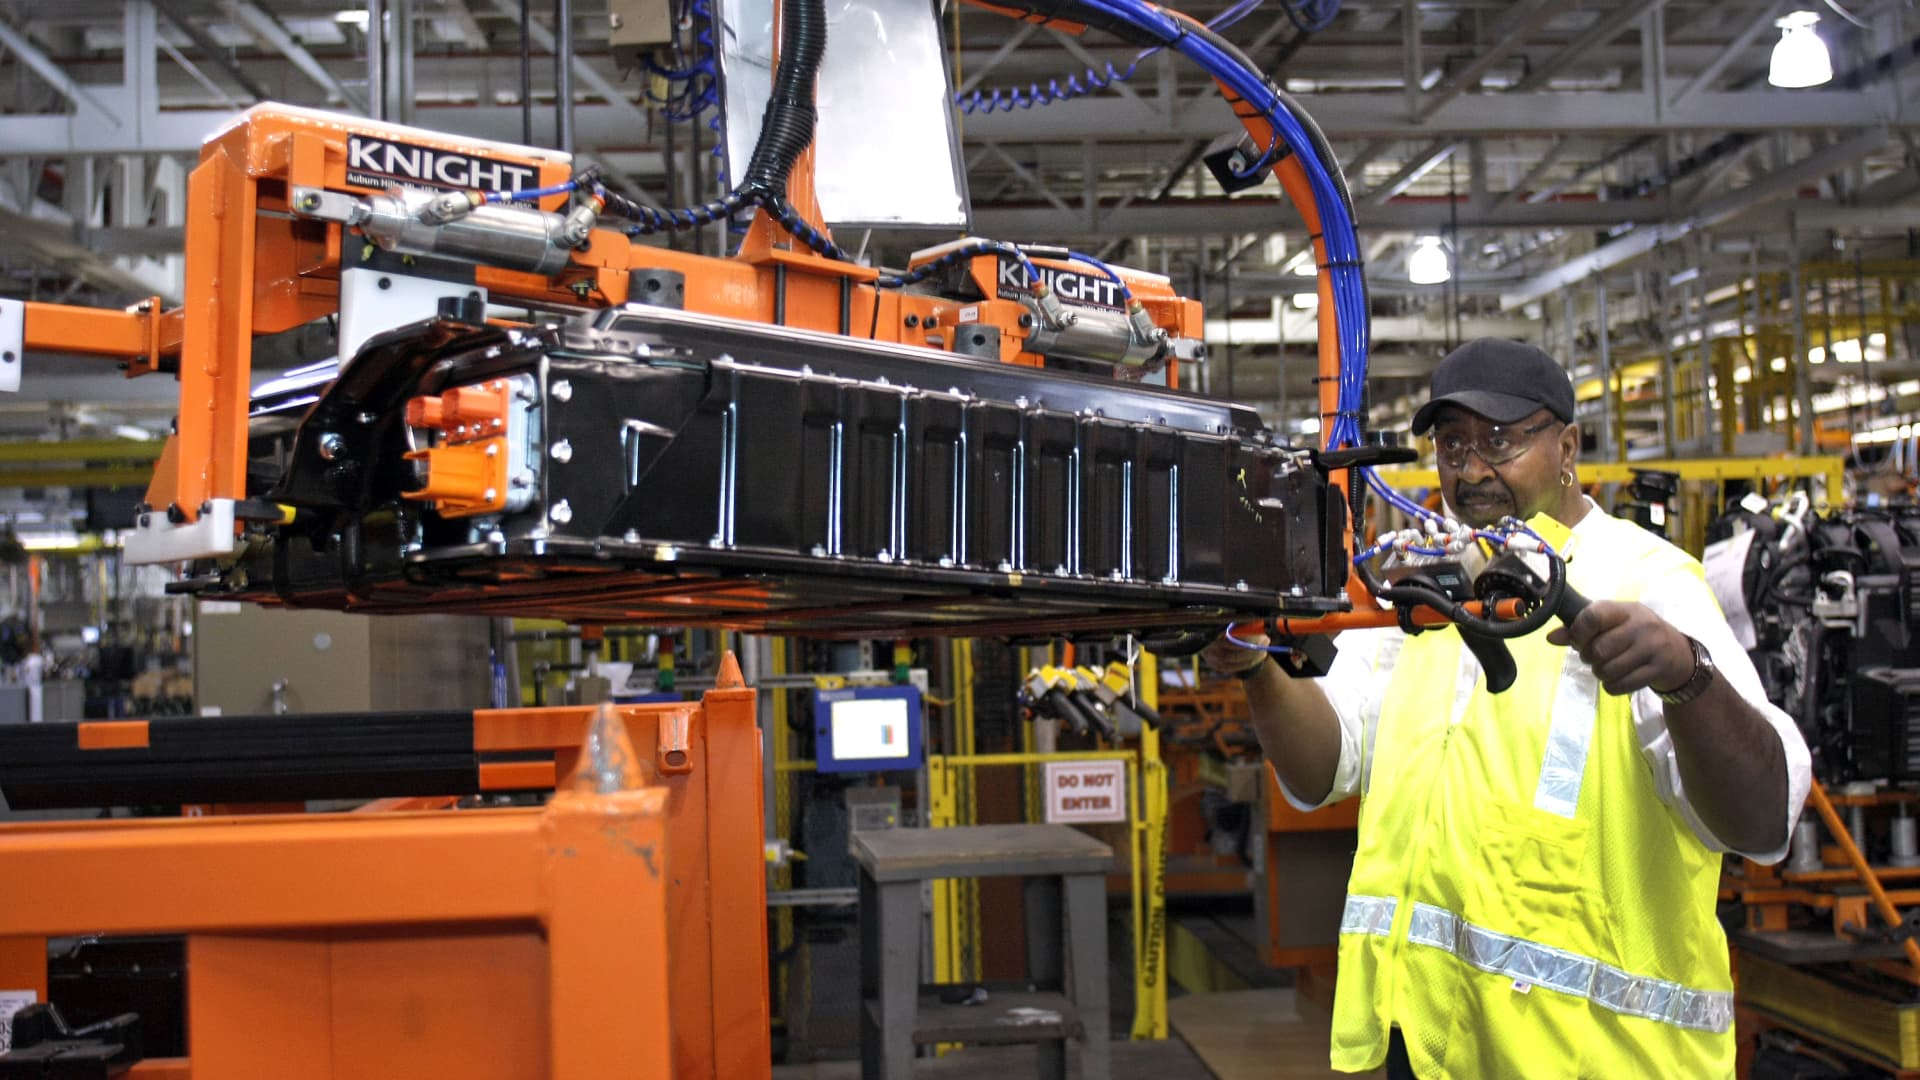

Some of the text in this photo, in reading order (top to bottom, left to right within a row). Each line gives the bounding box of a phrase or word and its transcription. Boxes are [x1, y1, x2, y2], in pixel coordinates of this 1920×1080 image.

[349, 138, 533, 194] KNIGHT
[347, 173, 379, 188] Auburn
[1058, 773, 1114, 788] DO NOT
[1062, 796, 1112, 811] ENTER
[1145, 905, 1166, 988] CAUTION
